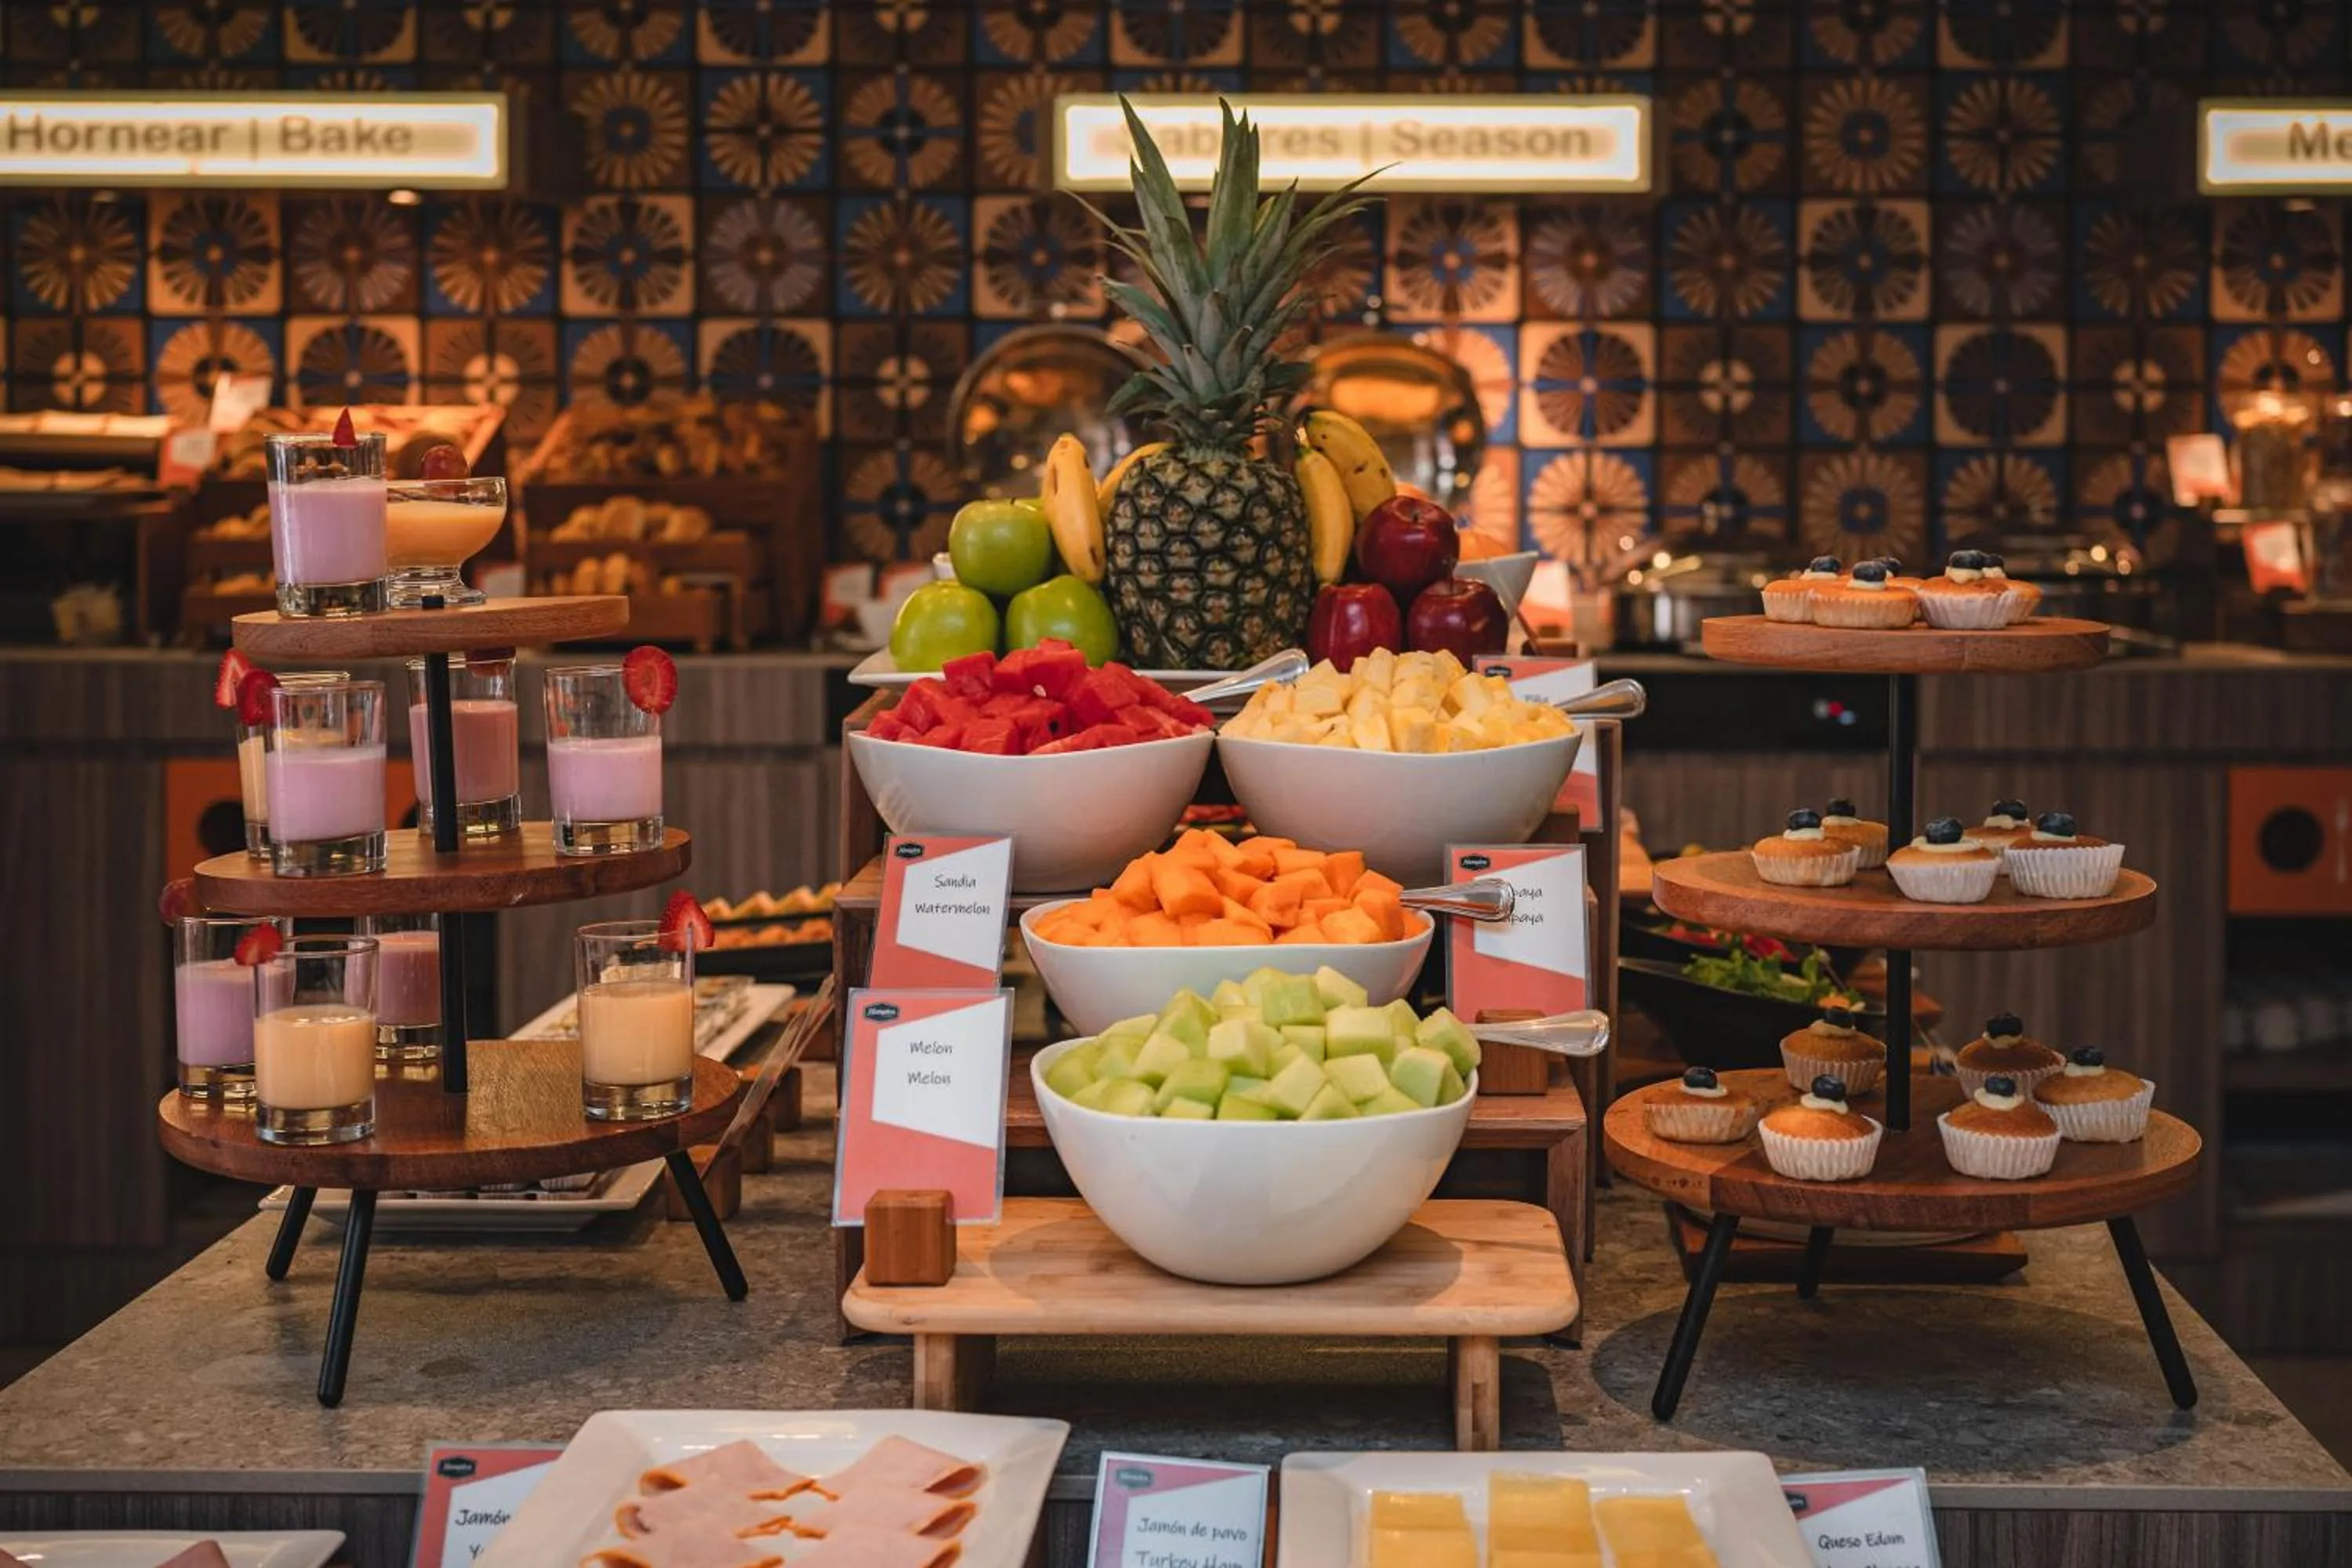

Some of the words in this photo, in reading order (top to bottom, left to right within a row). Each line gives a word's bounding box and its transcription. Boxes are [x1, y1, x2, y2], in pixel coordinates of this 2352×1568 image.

[6, 113, 230, 156] Hornear
[278, 116, 415, 157] Bake
[1116, 121, 1342, 158] abres
[1391, 119, 1592, 158] Season
[915, 902, 990, 915] Watermelon
[1508, 913, 1544, 925] paya
[907, 1070, 951, 1085] Melon
[1191, 1521, 1207, 1537] de
[1212, 1526, 1248, 1541] pavo
[1818, 1534, 1862, 1551] Queso
[1864, 1531, 1905, 1548] Edam
